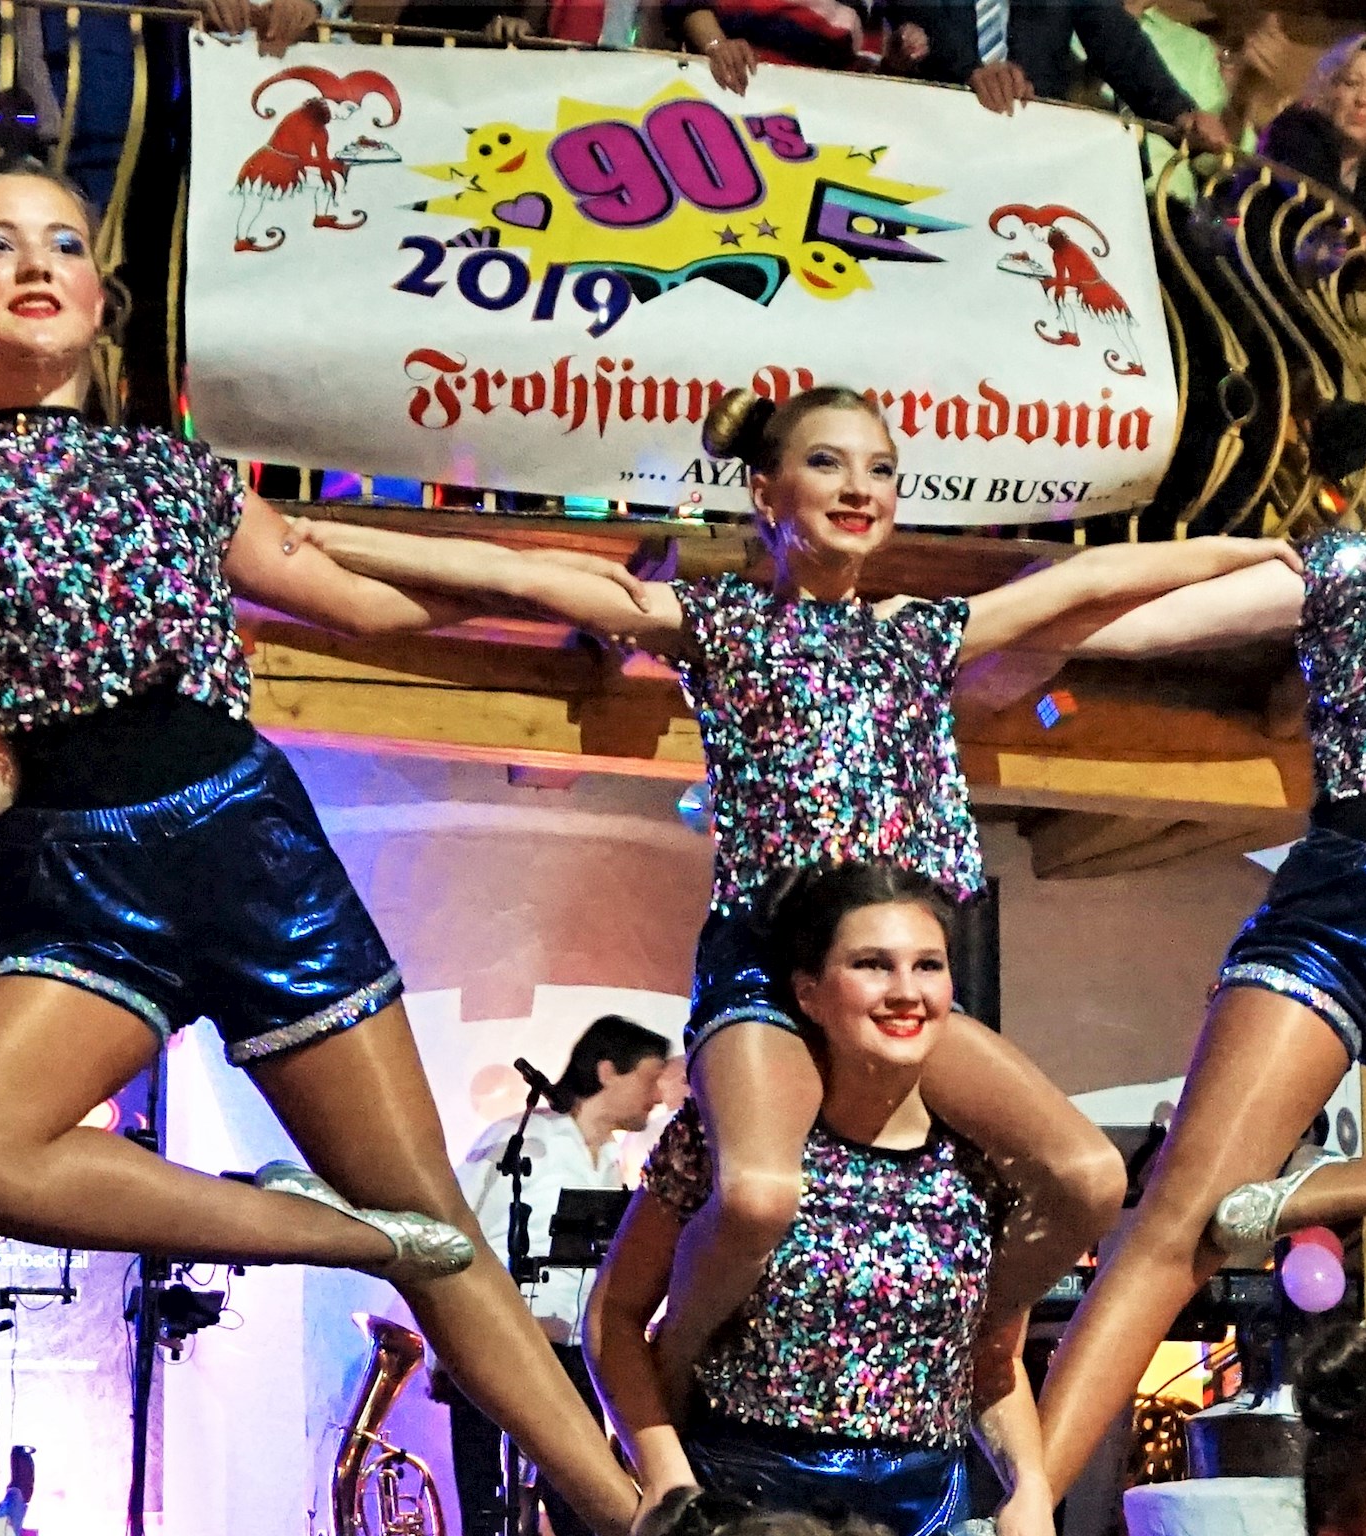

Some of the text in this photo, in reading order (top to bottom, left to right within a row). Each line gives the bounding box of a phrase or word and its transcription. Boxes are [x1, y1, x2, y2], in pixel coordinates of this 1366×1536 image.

[548, 97, 819, 230] 90's
[391, 235, 635, 339] 2019
[896, 473, 978, 501] USSI
